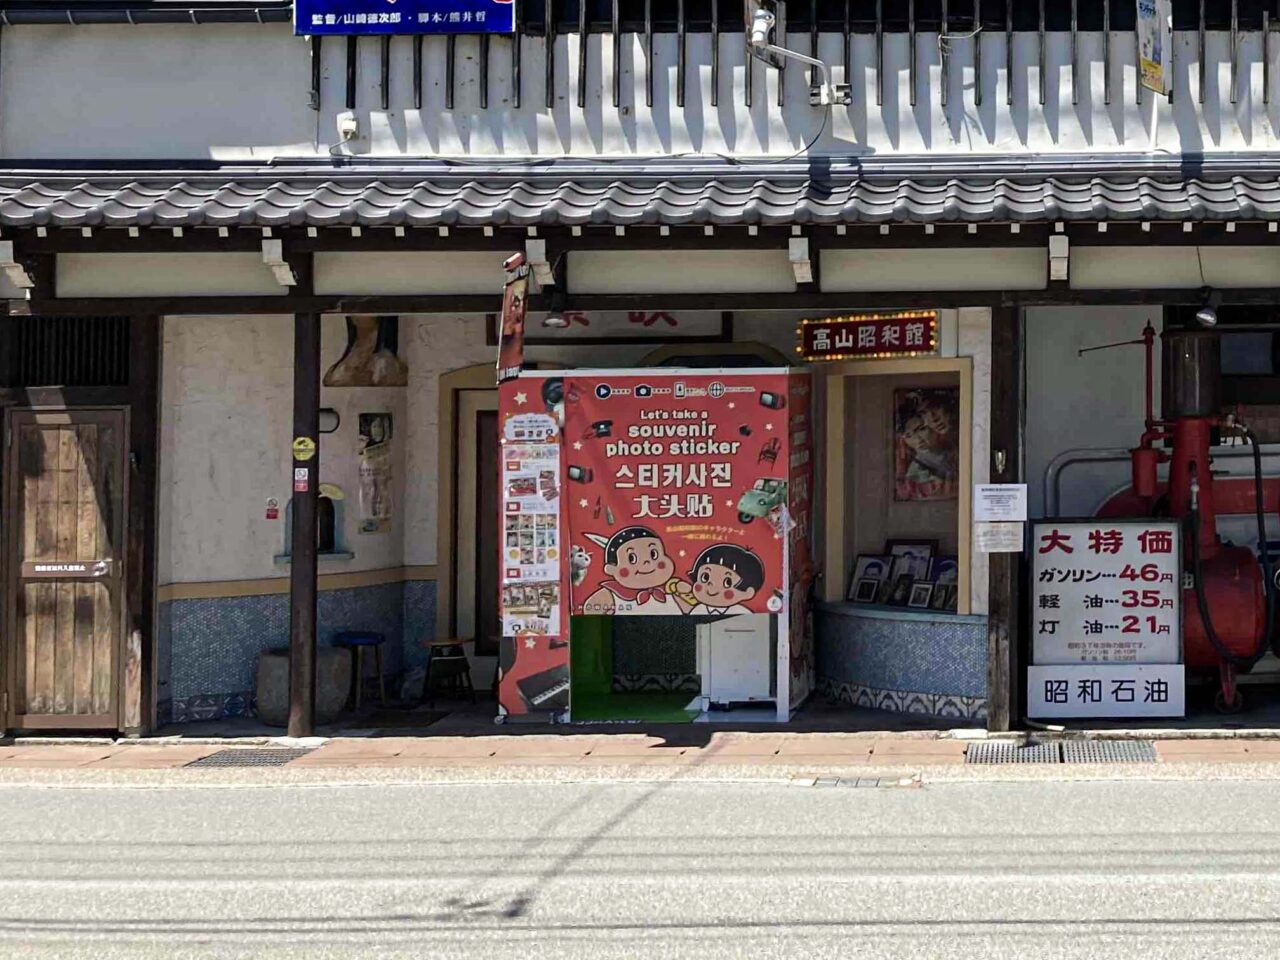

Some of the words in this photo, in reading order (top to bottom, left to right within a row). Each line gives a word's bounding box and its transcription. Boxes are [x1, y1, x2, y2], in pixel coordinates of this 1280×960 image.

[812, 323, 924, 351] 高山昭和館
[640, 410, 669, 420] Let's
[672, 410, 698, 420] take
[628, 420, 717, 438] souvenir
[606, 440, 664, 458] photo
[669, 439, 741, 455] sticker
[614, 462, 733, 490] 스티커사진
[632, 493, 714, 519] 大头贴
[1039, 529, 1173, 554] 大特価
[1045, 679, 1169, 703] 昭和石油
